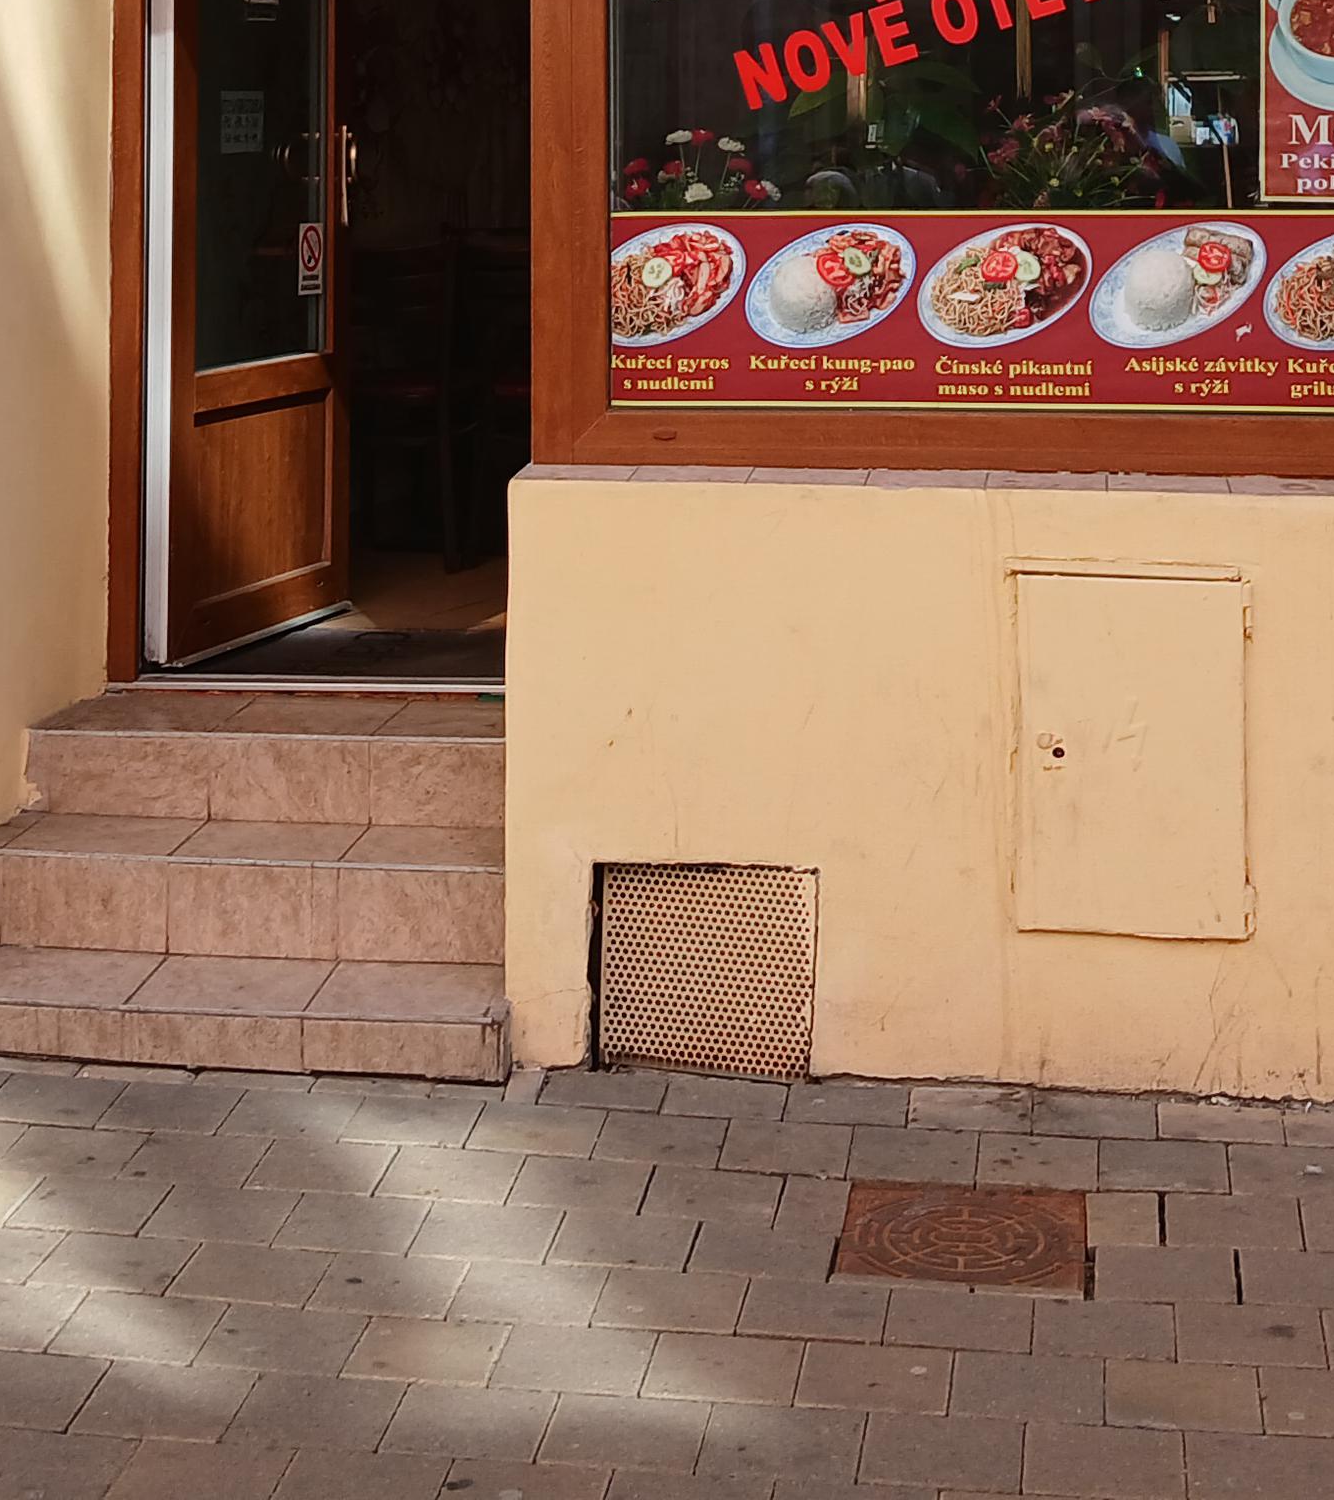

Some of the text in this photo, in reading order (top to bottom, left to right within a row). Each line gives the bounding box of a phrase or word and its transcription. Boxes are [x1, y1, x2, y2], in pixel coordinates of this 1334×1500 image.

[610, 354, 730, 373] Kuřecí gyros
[749, 355, 915, 374] Kuřecí kung-pao
[935, 355, 1092, 379] Čínské pikantní
[1124, 356, 1279, 377] Asijské závitky
[623, 376, 714, 390] s nudlemi
[804, 376, 859, 394] s rýží
[938, 382, 1090, 396] maso s nudlemi
[1174, 379, 1229, 397] s rýží
